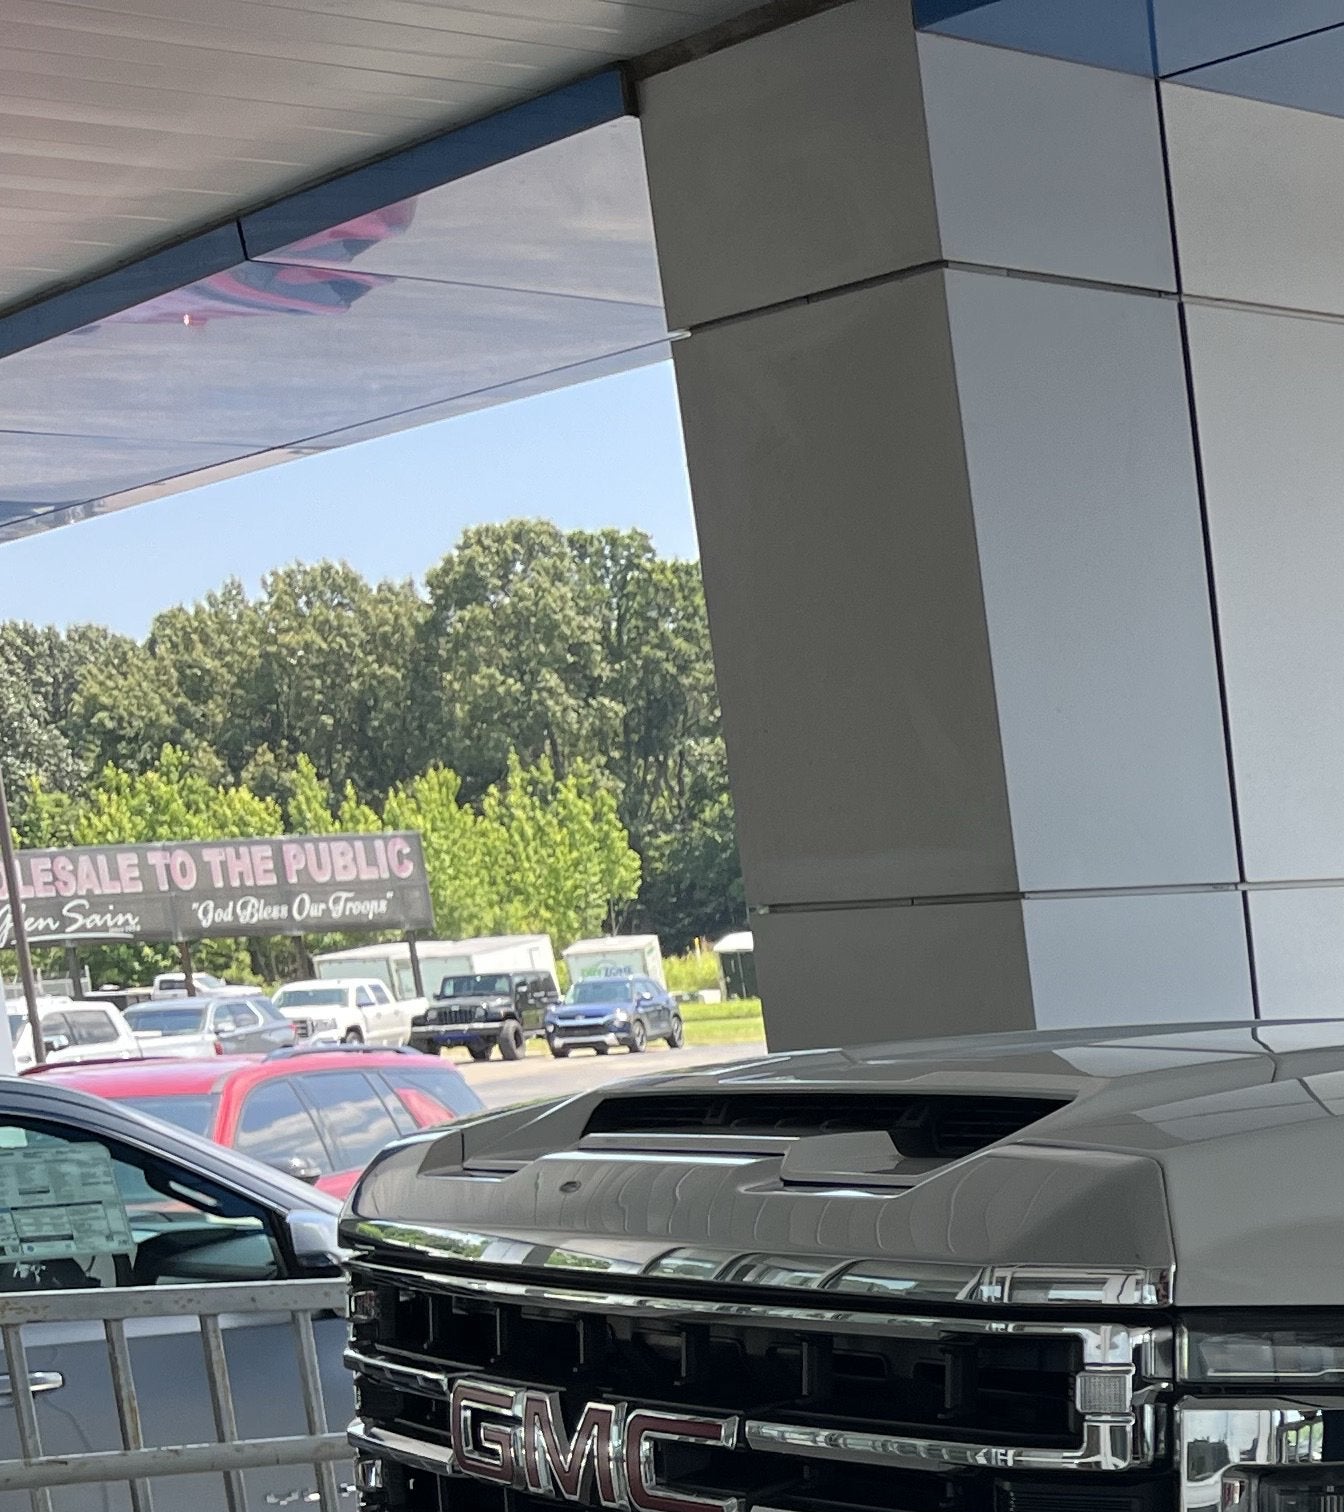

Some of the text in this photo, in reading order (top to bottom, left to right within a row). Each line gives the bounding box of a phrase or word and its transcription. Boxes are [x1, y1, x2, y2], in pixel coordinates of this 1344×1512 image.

[147, 849, 197, 892] TO
[202, 844, 277, 888] THE
[282, 837, 414, 884] PUBLIC
[62, 899, 139, 933] Sain
[236, 895, 288, 924] Bless
[292, 892, 327, 921] Our
